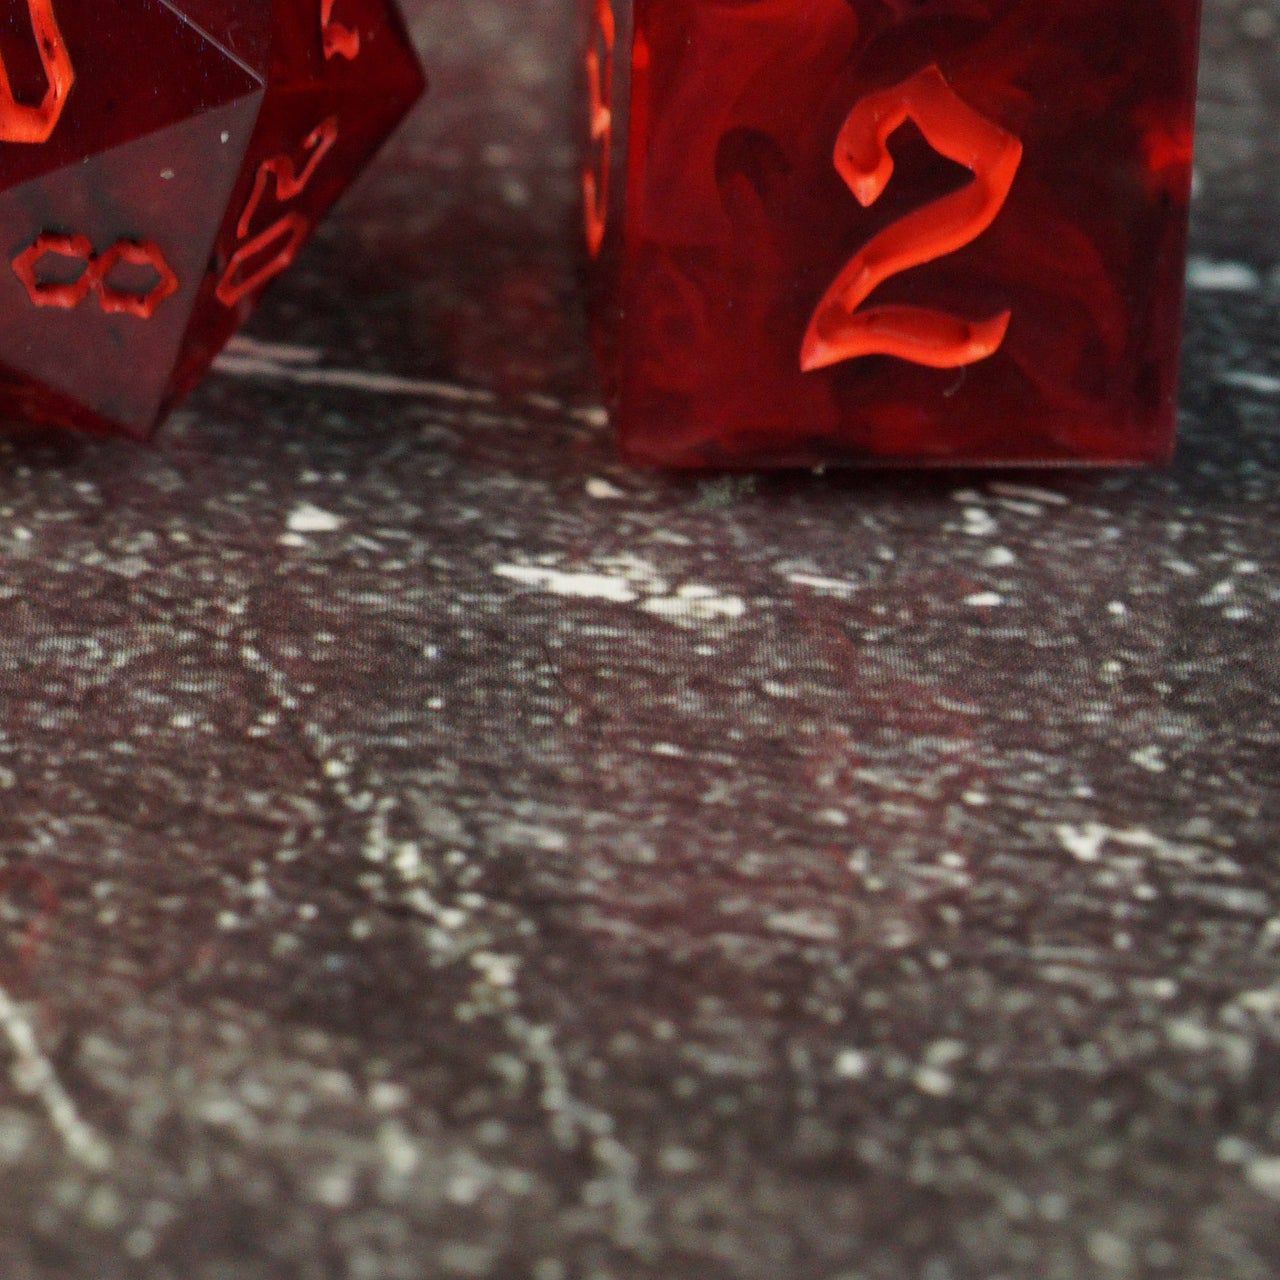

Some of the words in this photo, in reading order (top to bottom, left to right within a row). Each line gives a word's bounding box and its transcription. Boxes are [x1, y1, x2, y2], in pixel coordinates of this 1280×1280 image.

[10, 231, 179, 319] 8
[215, 119, 339, 308] 20
[799, 64, 1024, 373] 2
